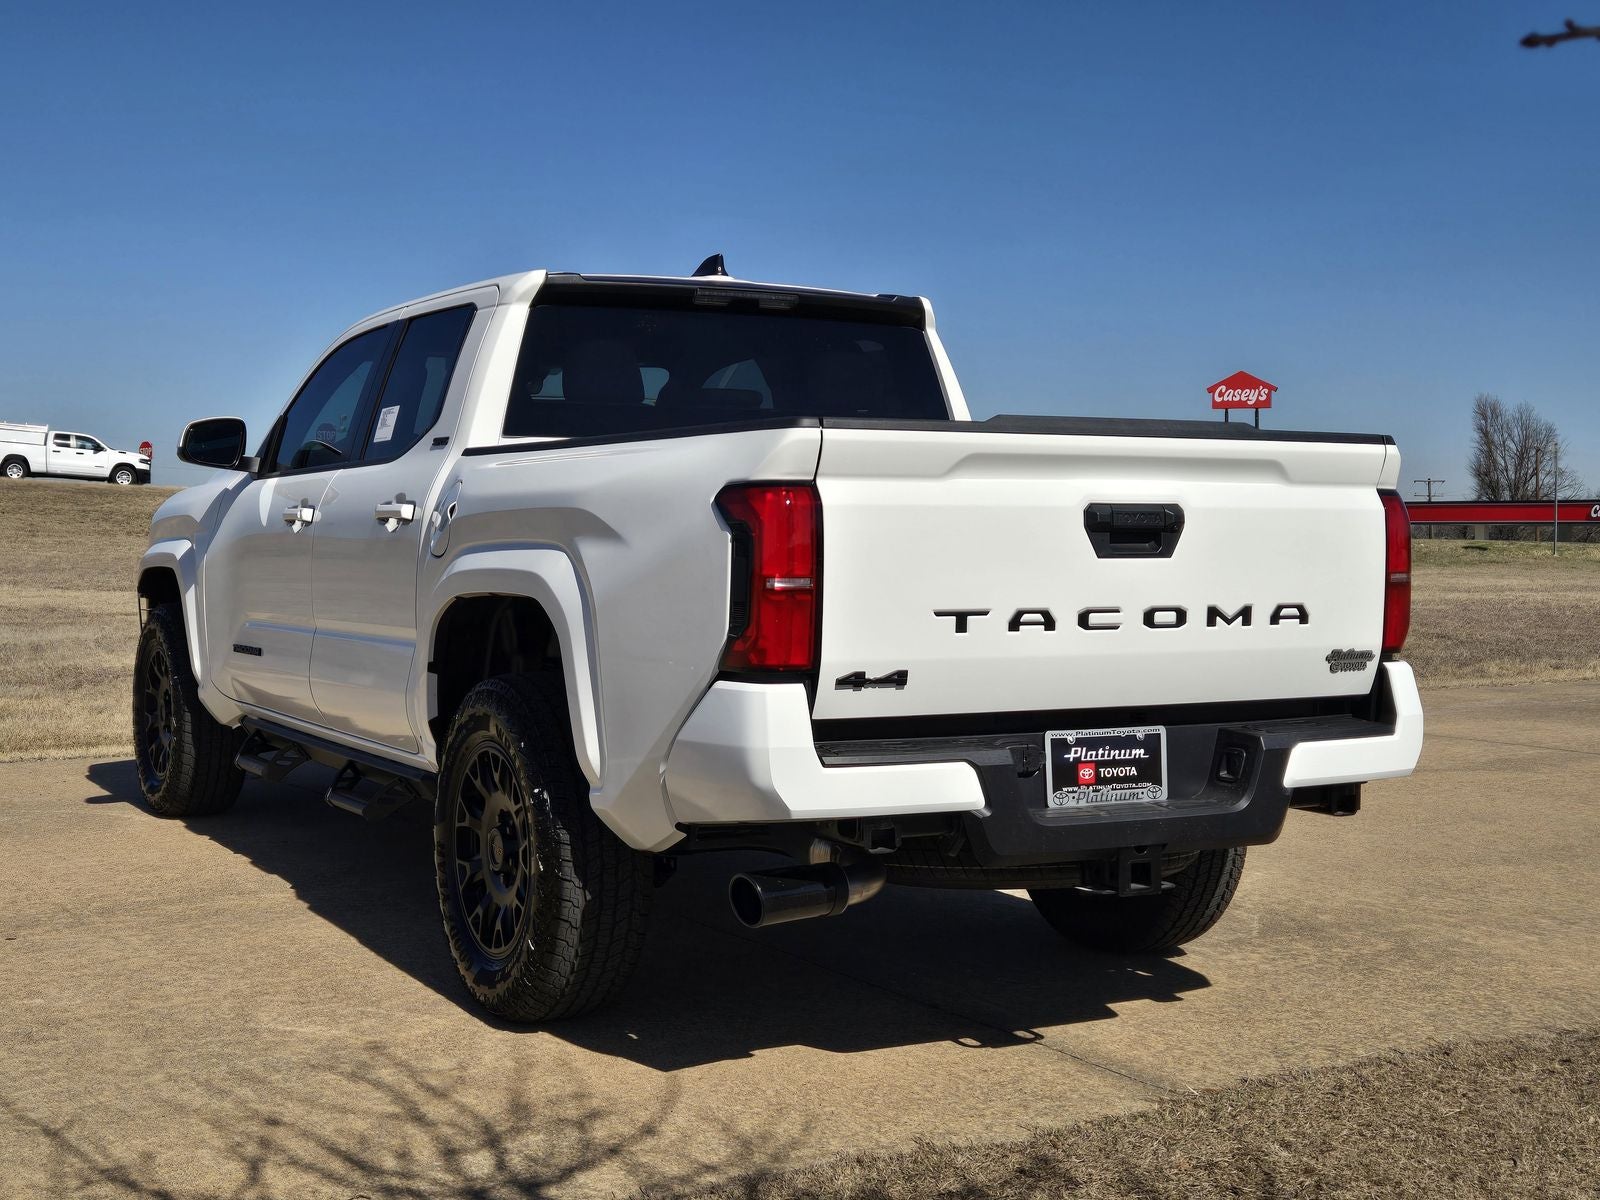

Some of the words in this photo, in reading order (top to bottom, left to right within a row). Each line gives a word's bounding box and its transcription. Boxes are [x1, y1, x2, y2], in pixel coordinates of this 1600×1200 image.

[1214, 385, 1268, 404] Casey's
[933, 603, 1310, 633] TACOMA
[1051, 728, 1160, 738] www.PlatinumToyota.com
[1064, 746, 1149, 761] Platinum
[1099, 767, 1137, 777] TOYOTA
[1076, 789, 1143, 804] Platinum
